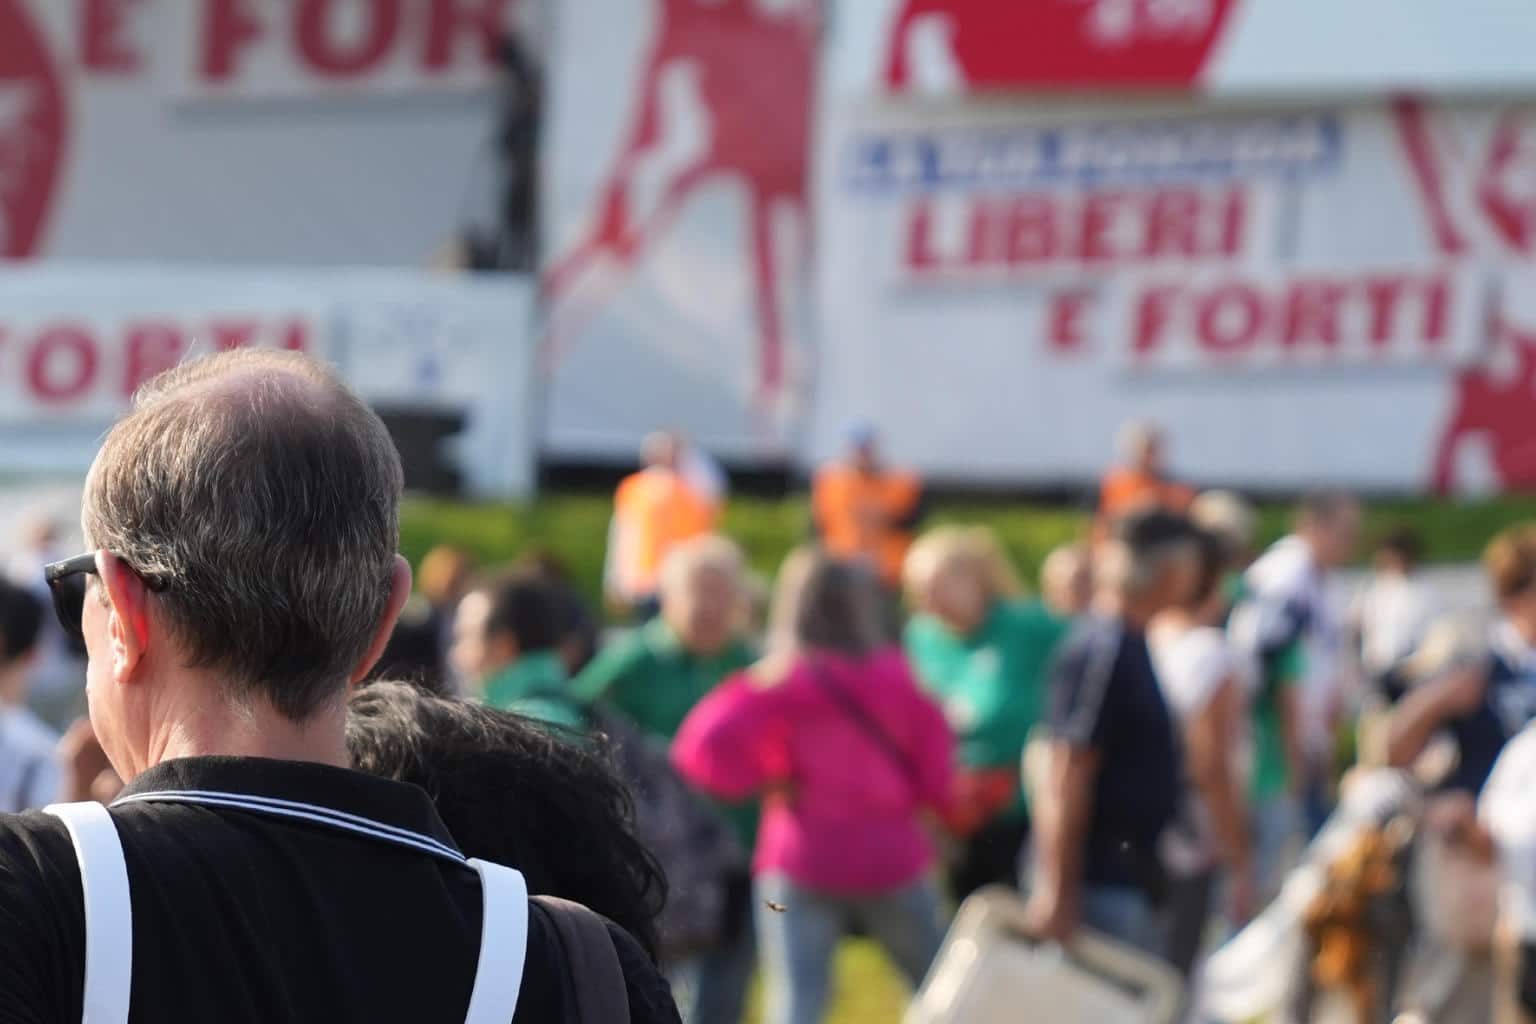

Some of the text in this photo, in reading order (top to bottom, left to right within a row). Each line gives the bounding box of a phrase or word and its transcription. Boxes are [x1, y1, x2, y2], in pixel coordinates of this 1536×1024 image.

[904, 188, 1248, 272] LIBERI
[1046, 272, 1454, 358] E FORTI
